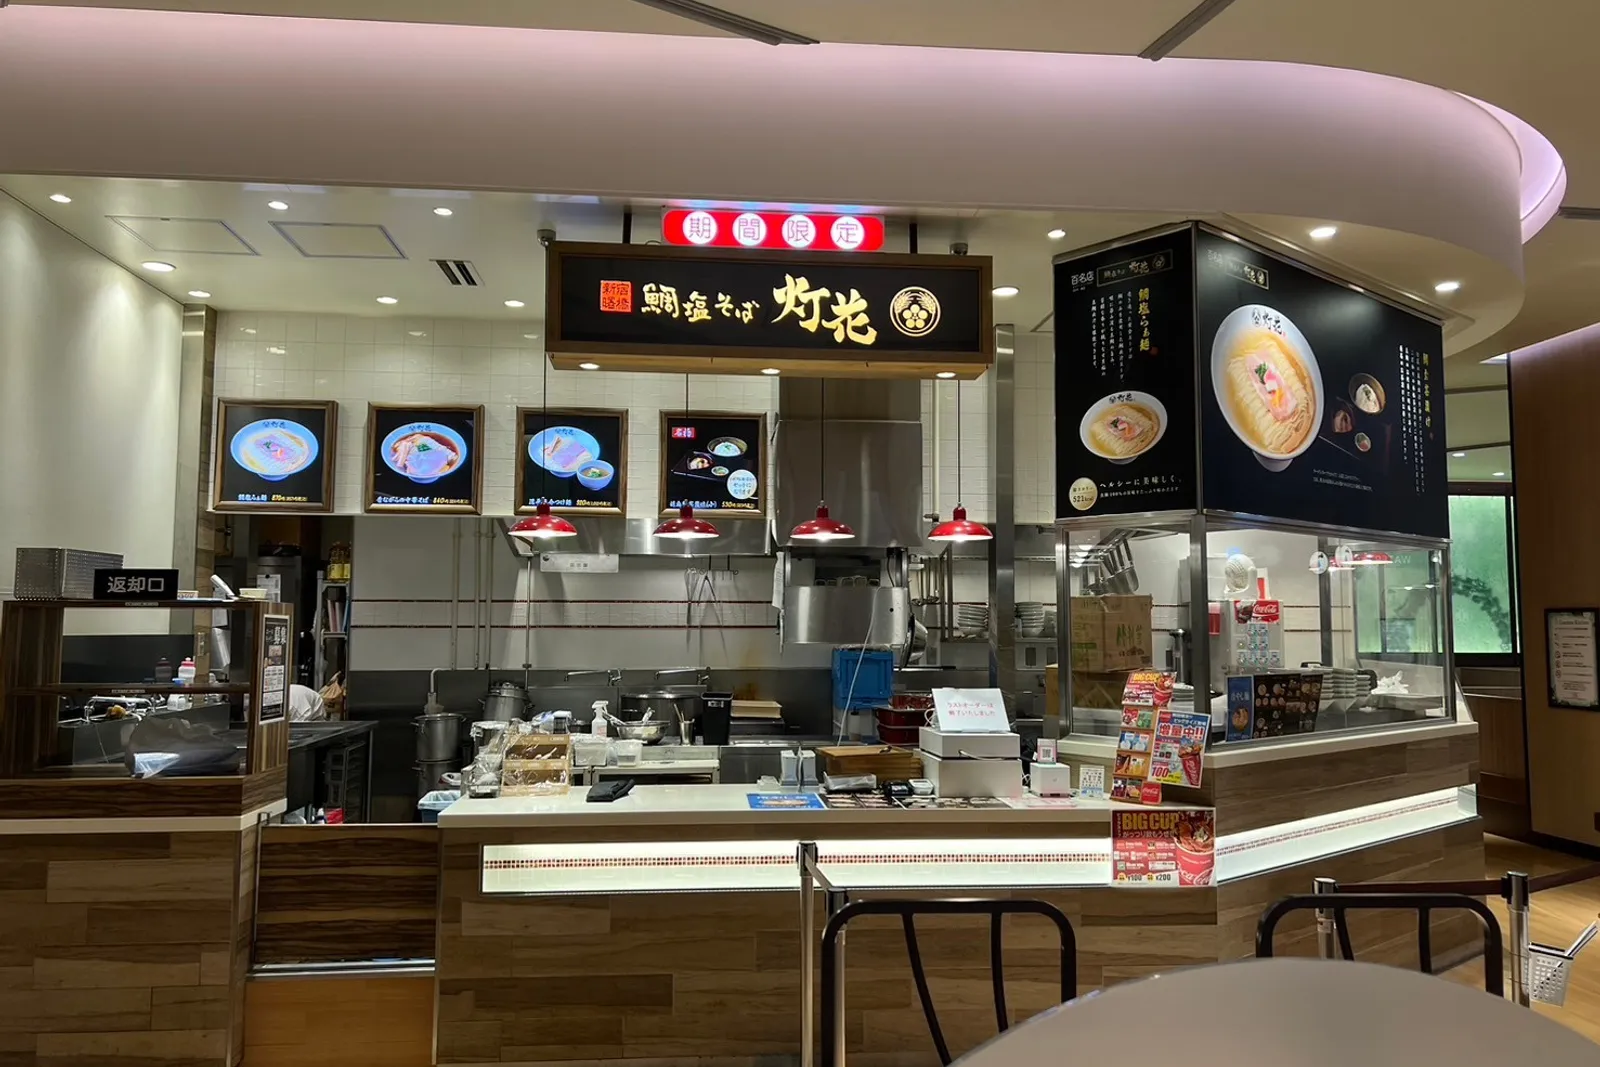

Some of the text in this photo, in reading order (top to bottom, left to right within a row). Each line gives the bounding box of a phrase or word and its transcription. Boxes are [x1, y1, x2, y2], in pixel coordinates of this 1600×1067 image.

[689, 217, 859, 244] 期間限定
[641, 273, 878, 346] 鯛塩そば 灯花
[107, 576, 164, 593] 返却口
[1122, 812, 1148, 830] BIG
[1149, 812, 1179, 830] CUP
